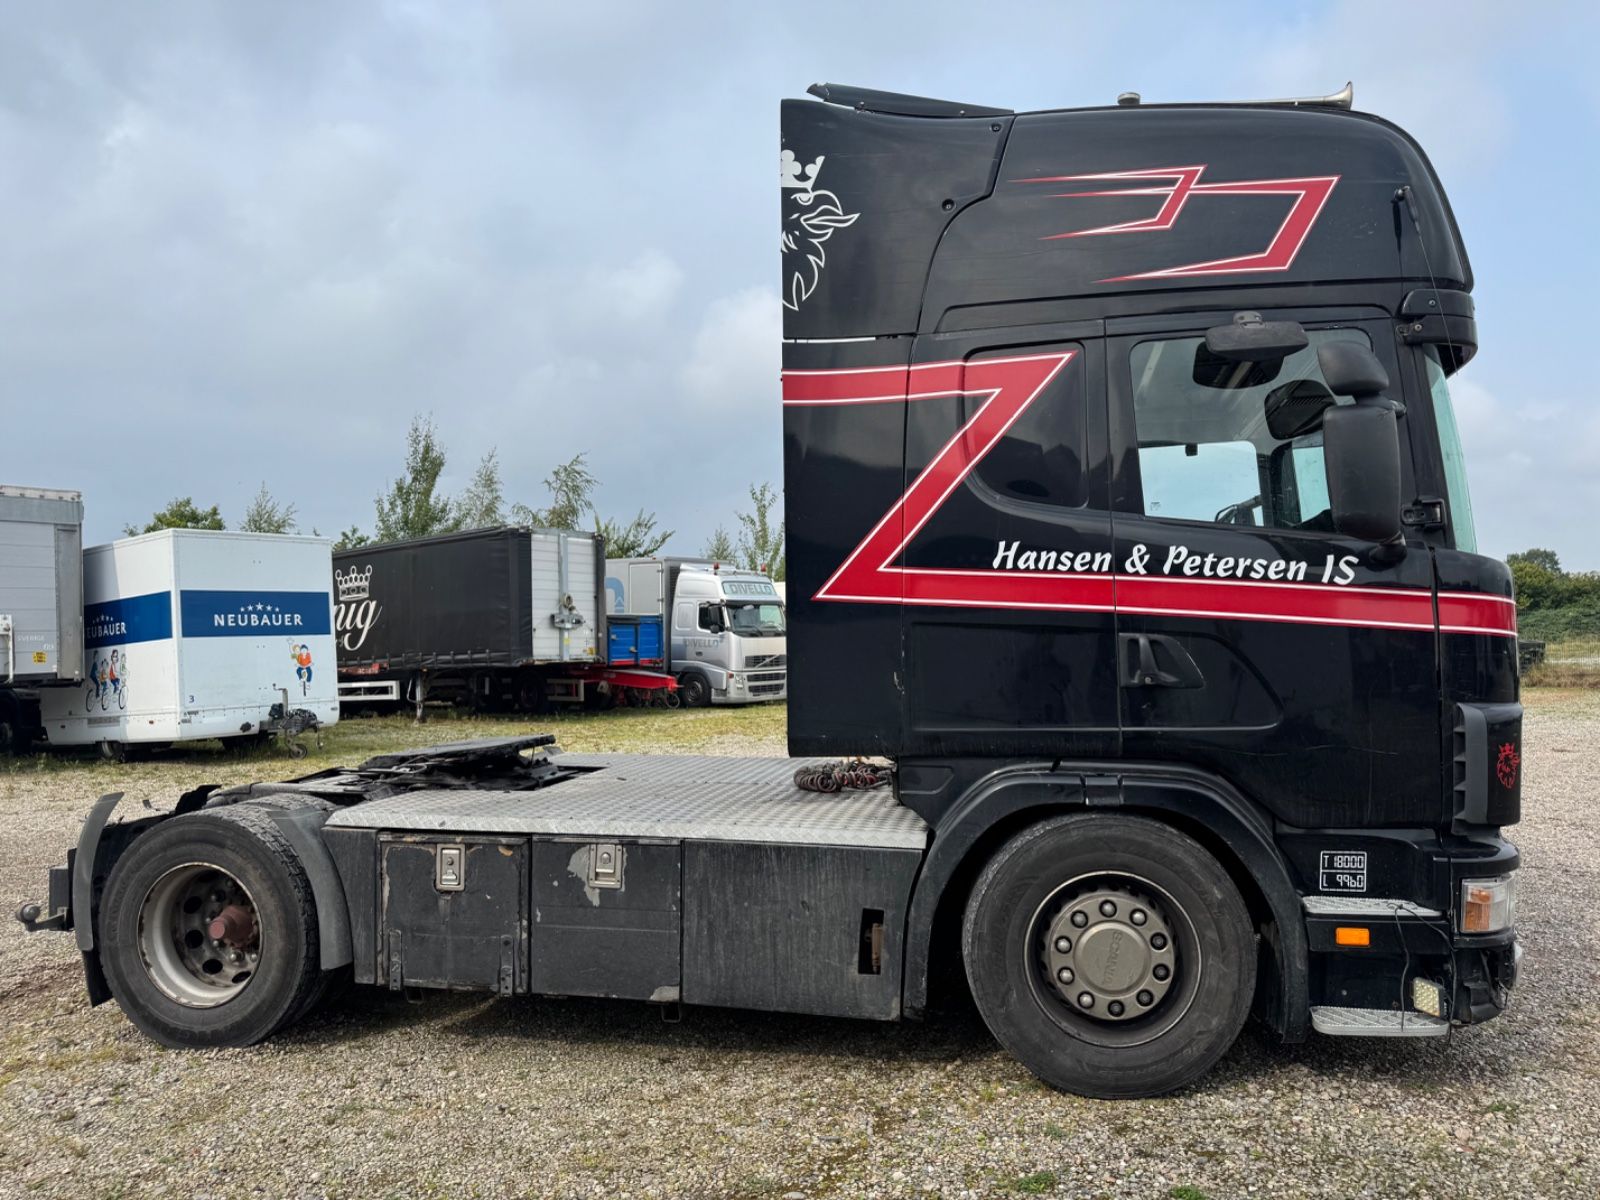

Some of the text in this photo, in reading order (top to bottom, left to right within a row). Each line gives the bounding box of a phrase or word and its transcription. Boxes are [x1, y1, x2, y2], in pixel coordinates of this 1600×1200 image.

[992, 540, 1359, 585] Hansen & Petersen IS
[730, 583, 772, 596] DIVELLO
[213, 613, 303, 627] NEUBAUER
[86, 621, 127, 639] EUBAUER
[1323, 855, 1364, 869] T 18000
[1322, 873, 1364, 888] L 9960
